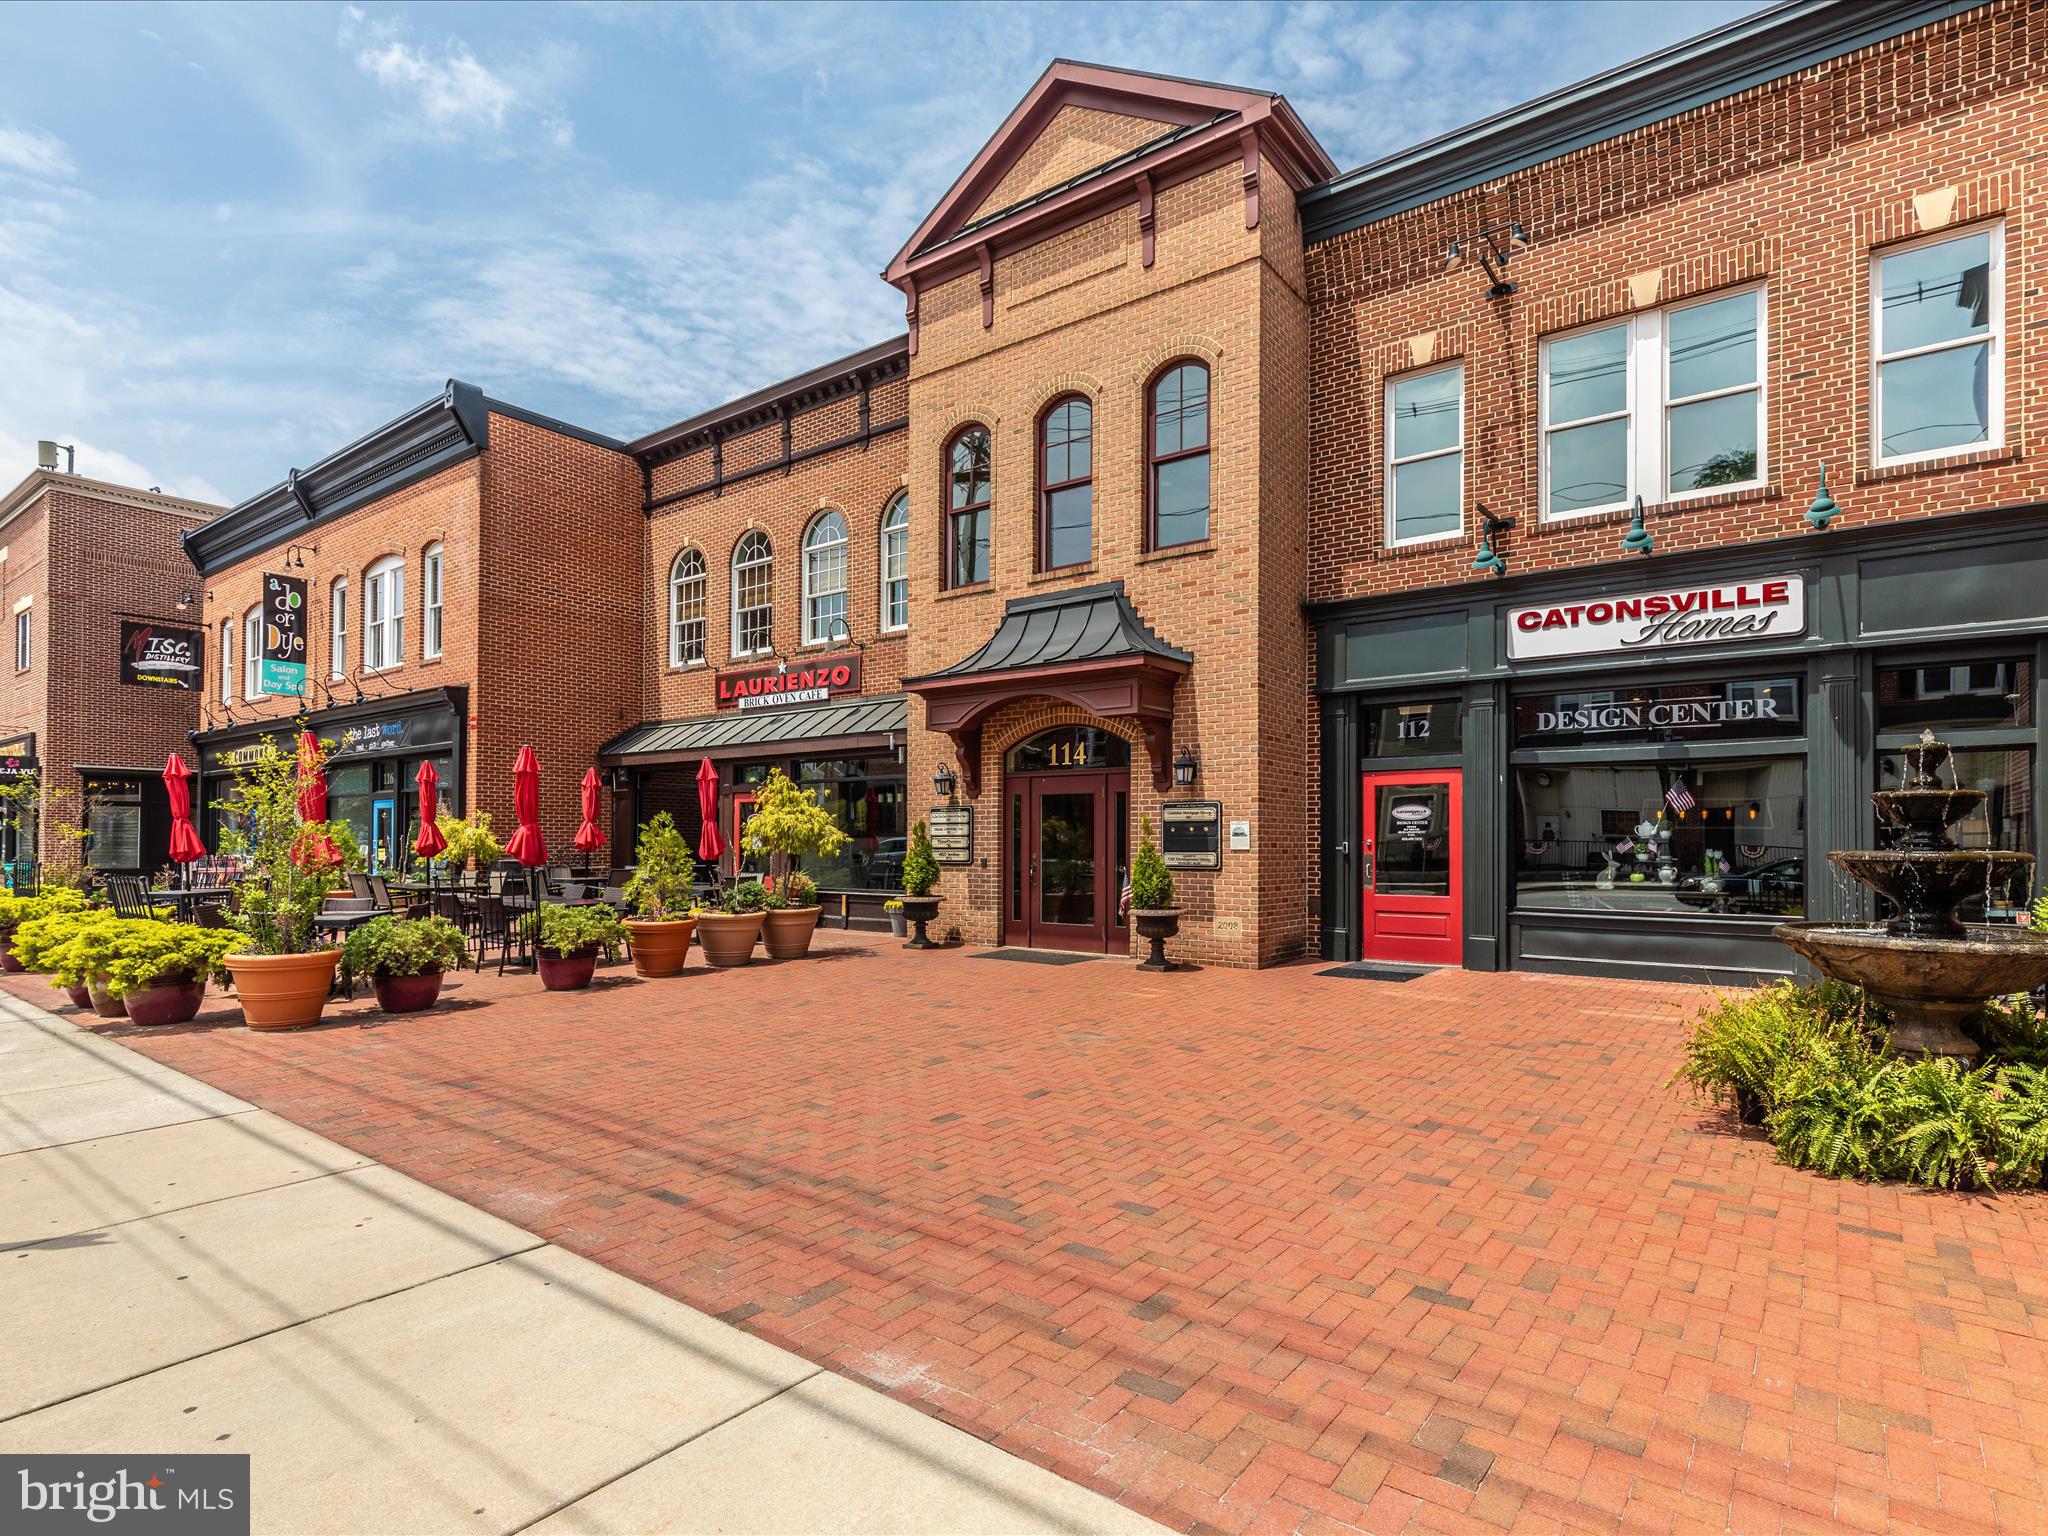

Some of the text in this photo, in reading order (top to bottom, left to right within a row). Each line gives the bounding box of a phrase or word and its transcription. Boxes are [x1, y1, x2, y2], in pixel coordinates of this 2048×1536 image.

[275, 583, 302, 612] do
[1516, 581, 1790, 631] CATONSVILLE
[276, 613, 295, 627] or
[1619, 609, 1778, 646] Homes
[266, 623, 305, 659] Dye
[145, 653, 191, 664] DISTILLERY
[270, 664, 298, 674] Salon
[137, 674, 178, 684] DOWNSTAIRS
[263, 680, 304, 691] Day Spa
[719, 665, 851, 699] LAURIENZO
[743, 695, 770, 708] BRICK
[772, 692, 797, 704] OVEN
[1537, 698, 1780, 731] DESIGN CENTER
[363, 723, 380, 740] last
[1397, 720, 1430, 738] 112
[1048, 741, 1087, 766] 114
[384, 772, 395, 785] 116
[1217, 921, 1239, 930] 2008
